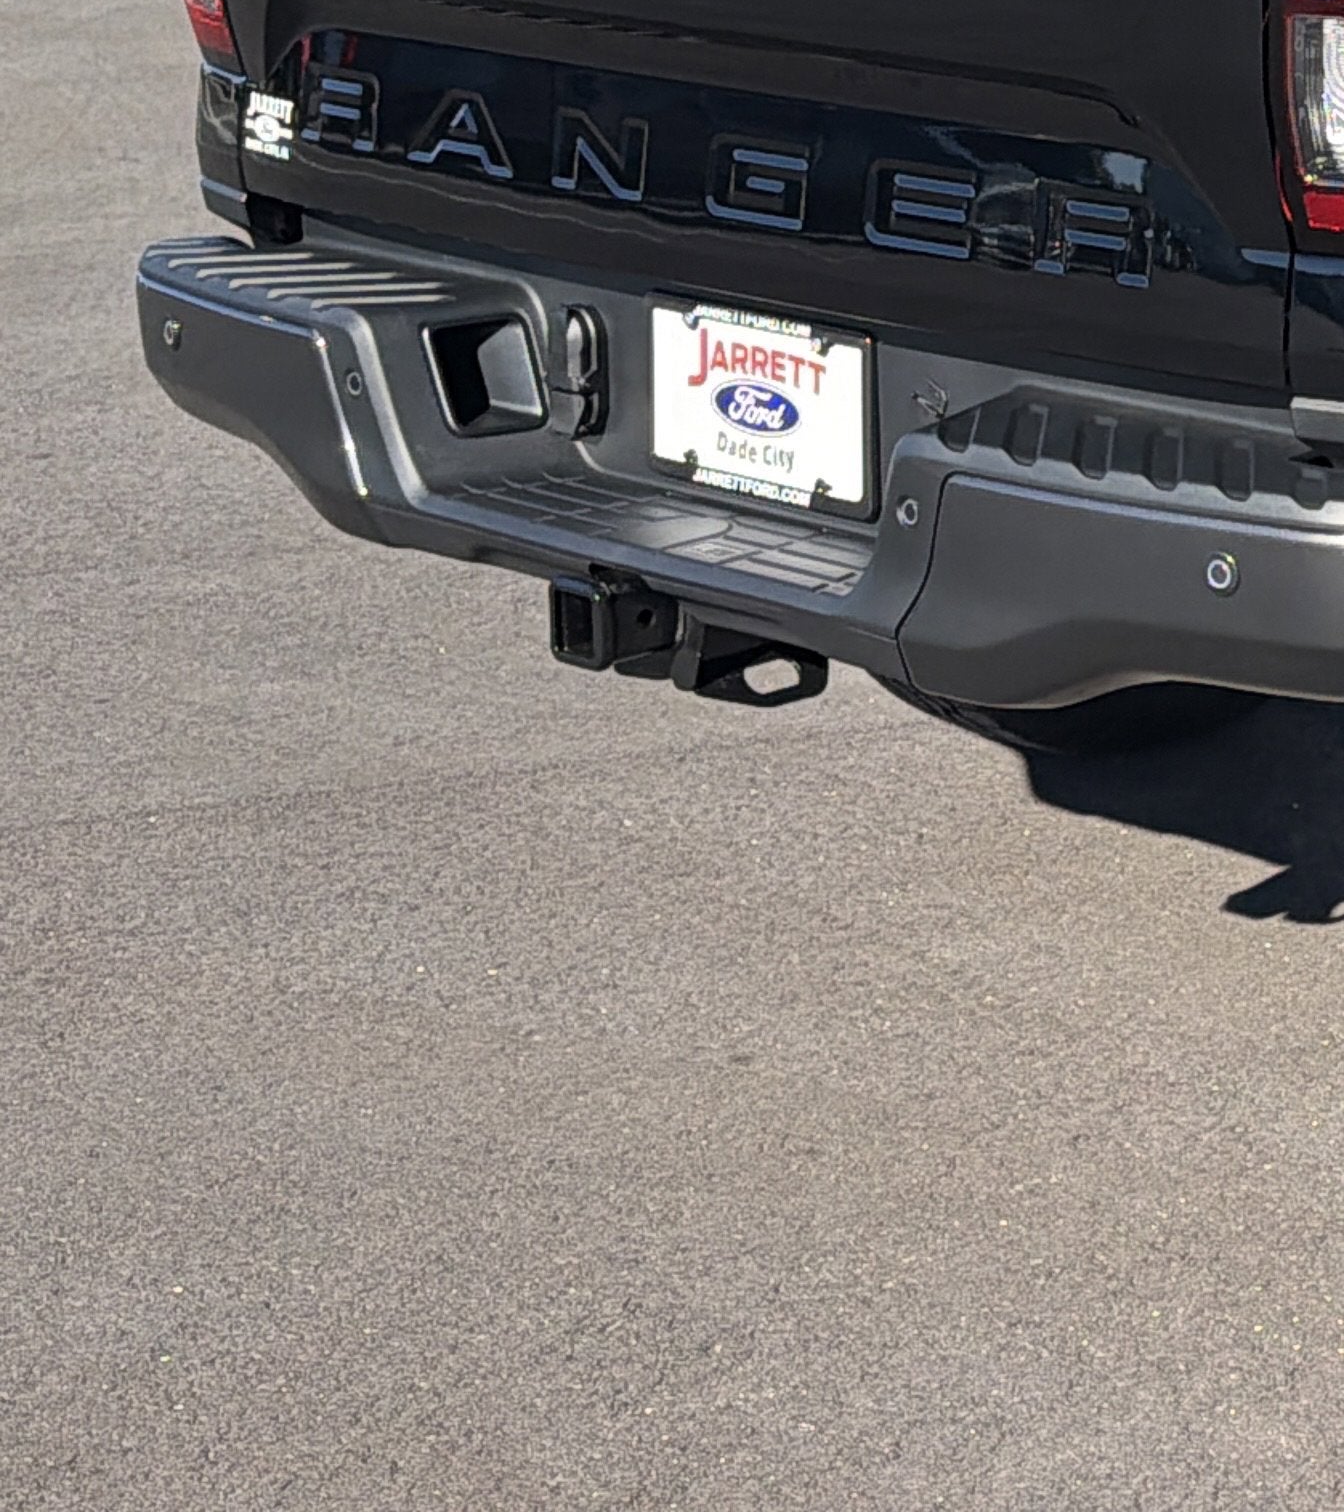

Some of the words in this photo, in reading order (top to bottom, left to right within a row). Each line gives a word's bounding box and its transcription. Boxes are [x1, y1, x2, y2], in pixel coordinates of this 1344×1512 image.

[300, 60, 1155, 288] RANGER
[687, 327, 827, 396] JARRETT
[727, 385, 787, 430] Ford
[716, 430, 758, 464] Dade
[762, 444, 796, 474] City
